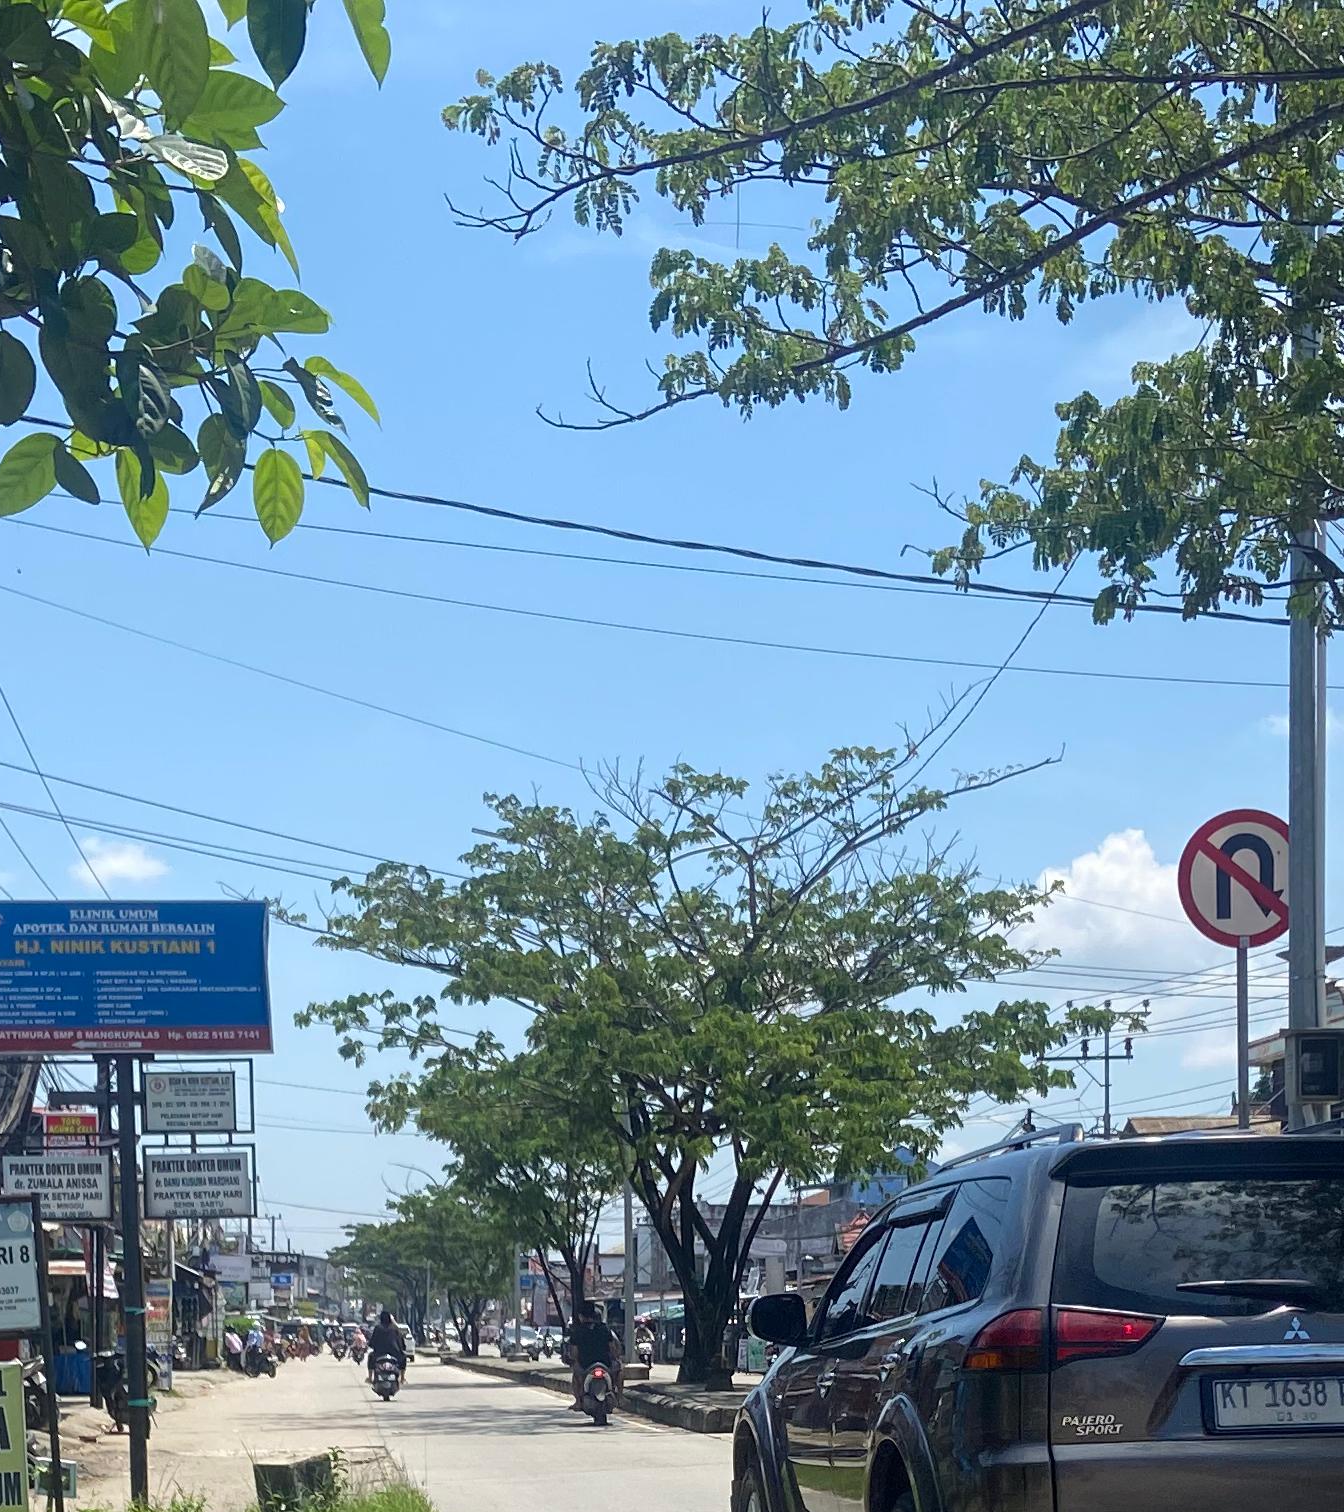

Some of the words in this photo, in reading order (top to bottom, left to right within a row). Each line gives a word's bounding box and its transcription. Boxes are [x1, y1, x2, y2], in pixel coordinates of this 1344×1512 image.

[70, 909, 116, 920] KLINIK
[119, 909, 159, 920] UMUM
[13, 923, 67, 935] APOTEK
[69, 923, 98, 934] DAN
[101, 923, 148, 934] RUMAH
[151, 923, 215, 935] BERSALIN
[50, 940, 106, 954] NINIK
[110, 940, 201, 954] KUSTIANI
[53, 1031, 74, 1040] SMP
[85, 1031, 160, 1040] MANGKUPALAS
[9, 1163, 44, 1176] PRAKTEK
[46, 1163, 75, 1175] DOKTER
[77, 1163, 102, 1175] UMUM
[152, 1160, 185, 1173] PRAKTEK
[186, 1160, 215, 1172] DOKTER
[217, 1159, 241, 1172] UMUM
[27, 1179, 64, 1189] ZUMALA
[65, 1178, 98, 1189] ANISSA
[52, 1192, 80, 1200] SETIAP
[83, 1192, 102, 1200] HARI
[154, 1191, 190, 1200] PRAKTEK
[193, 1191, 221, 1199] SETIAP
[223, 1190, 242, 1199] HARI
[19, 1245, 30, 1264] 8
[1221, 1381, 1252, 1409] KT
[1264, 1380, 1328, 1408] 1638
[1061, 1414, 1116, 1427] PAJERO
[1075, 1423, 1123, 1436] SPORT
